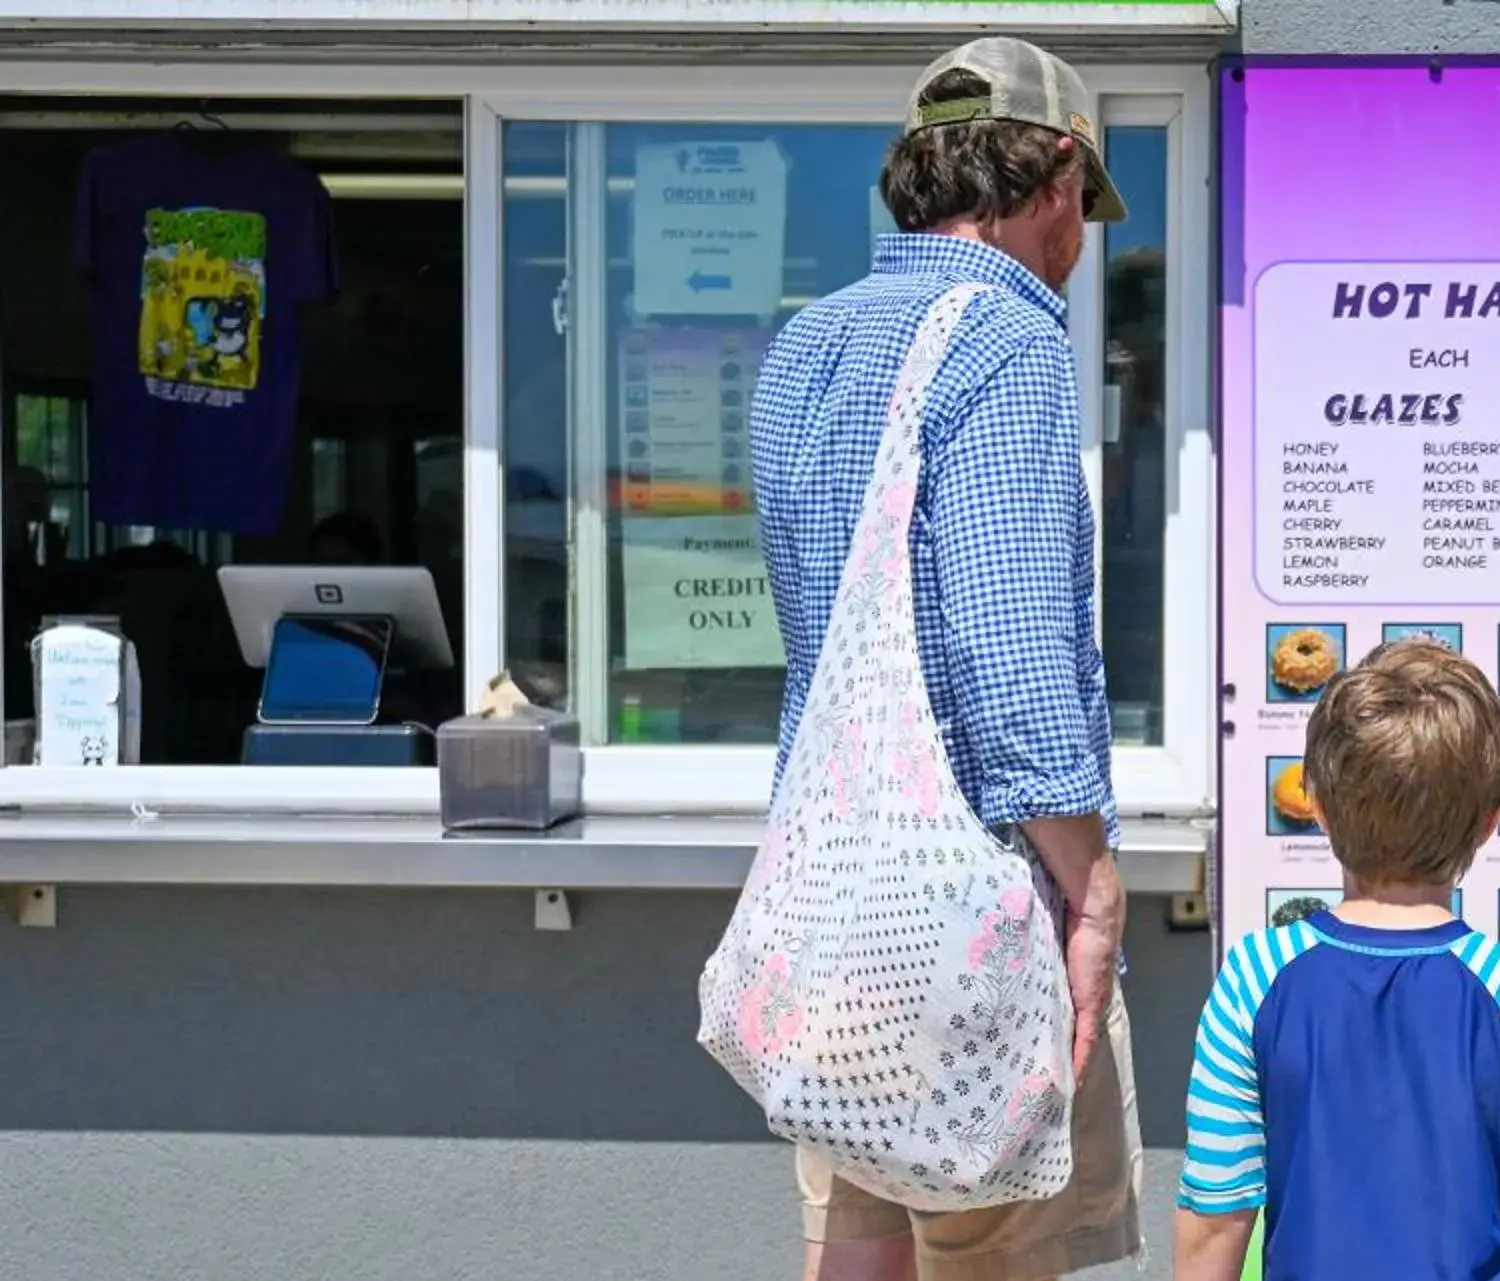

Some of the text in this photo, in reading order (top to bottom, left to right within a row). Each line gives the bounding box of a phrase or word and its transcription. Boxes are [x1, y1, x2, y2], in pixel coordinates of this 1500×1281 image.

[663, 186, 756, 202] ORDER HERE
[1333, 282, 1432, 319] HOT
[1410, 349, 1469, 368] EACH
[1324, 394, 1462, 426] GLAZES
[1283, 442, 1339, 456] HONEY
[1283, 461, 1347, 474] BANANA
[1424, 461, 1478, 475] MOCHA
[1283, 480, 1374, 494] CHOCOLATE
[1424, 480, 1475, 494] MIXED
[1283, 499, 1332, 512] MAPLE
[1283, 518, 1342, 531] CHERRY
[1423, 518, 1494, 531] CARAMEL
[1284, 536, 1385, 550] STRAWBERRY
[1424, 537, 1485, 550] PEANUT
[1283, 555, 1338, 569] LEMON
[1423, 555, 1487, 568] ORANGE
[673, 577, 767, 598] CREDIT
[1283, 574, 1368, 588] RASPBERRY
[689, 610, 756, 630] ONLY
